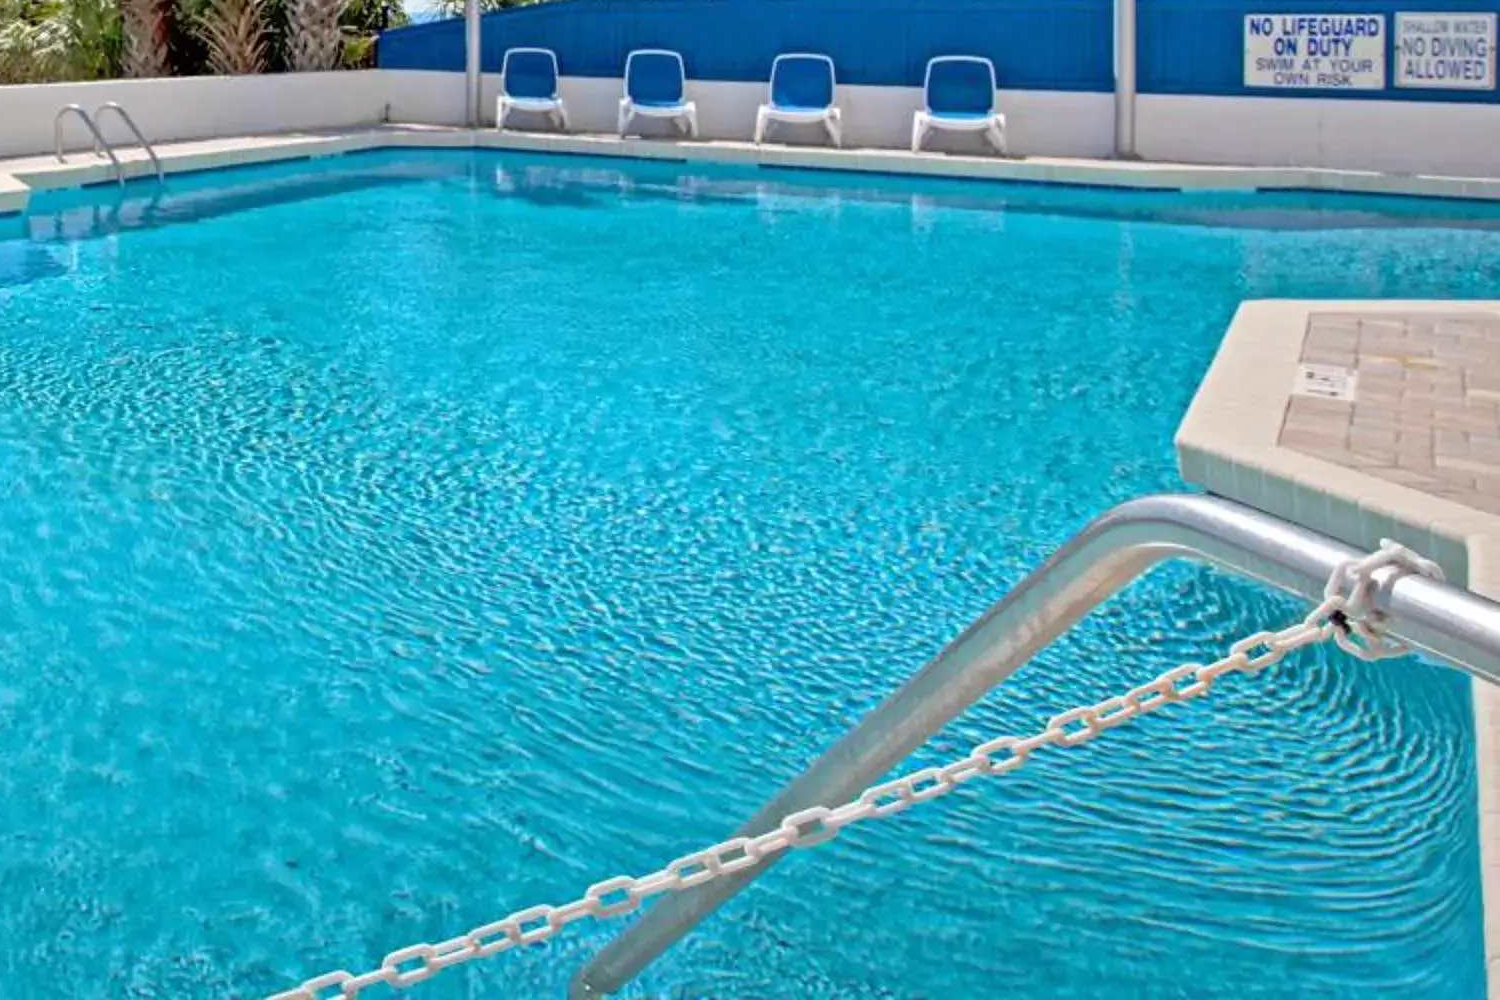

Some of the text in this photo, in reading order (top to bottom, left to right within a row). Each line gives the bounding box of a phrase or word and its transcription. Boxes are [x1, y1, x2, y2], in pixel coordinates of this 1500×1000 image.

[1250, 18, 1379, 36] NO LIFEGUARD
[1274, 38, 1353, 56] ON DUTY
[1403, 37, 1486, 57] NO DIVING
[1256, 58, 1372, 73] SWIM AT YOUR
[1405, 59, 1485, 80] ALLOWED
[1273, 72, 1351, 86] OWN RISK
